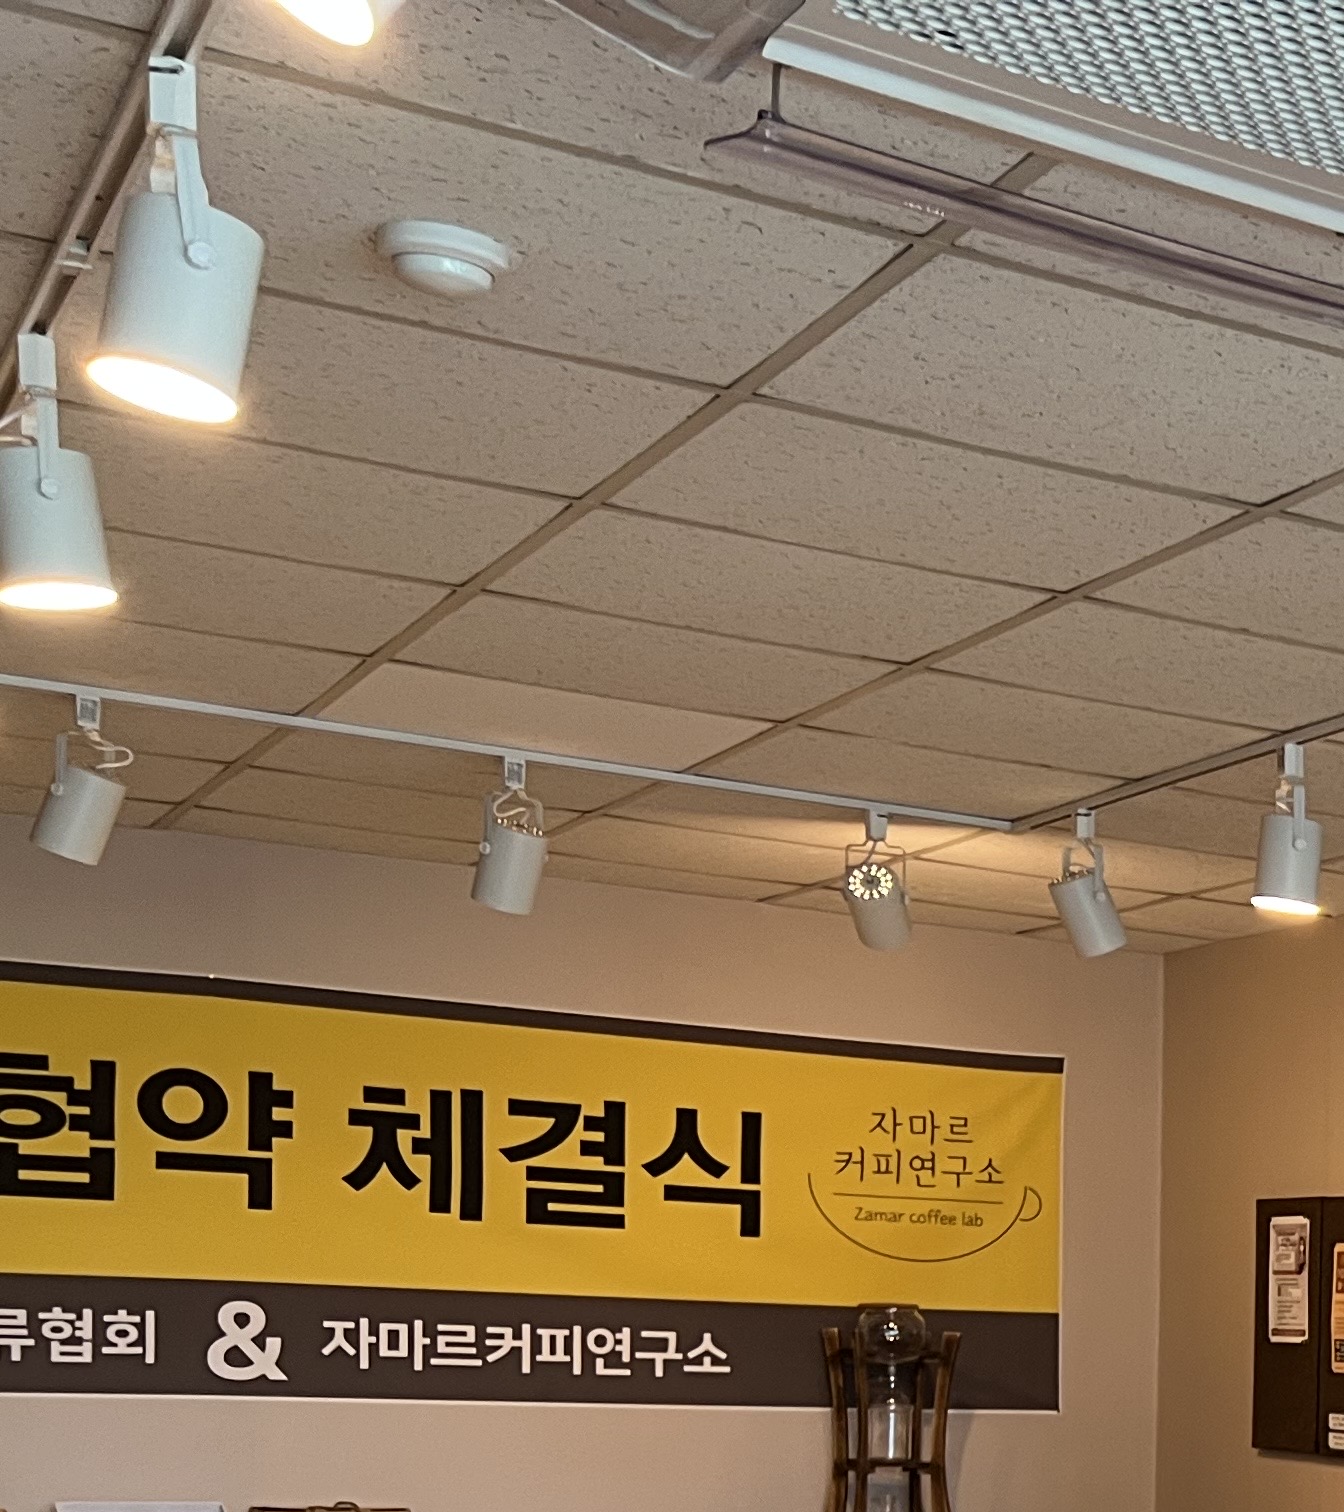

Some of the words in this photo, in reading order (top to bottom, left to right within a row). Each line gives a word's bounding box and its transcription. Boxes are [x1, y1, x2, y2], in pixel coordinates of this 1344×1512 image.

[0, 1052, 294, 1211] 협약
[342, 1086, 763, 1238] 체결식
[868, 1106, 974, 1146] 자마르
[833, 1146, 1005, 1188] 커피연구소
[853, 1206, 905, 1223] Zamar
[909, 1209, 957, 1226] coffee
[961, 1211, 984, 1228] lab
[0, 1306, 155, 1364] 류협회
[207, 1300, 289, 1382] &
[321, 1317, 732, 1378] 자마르커피연구소
